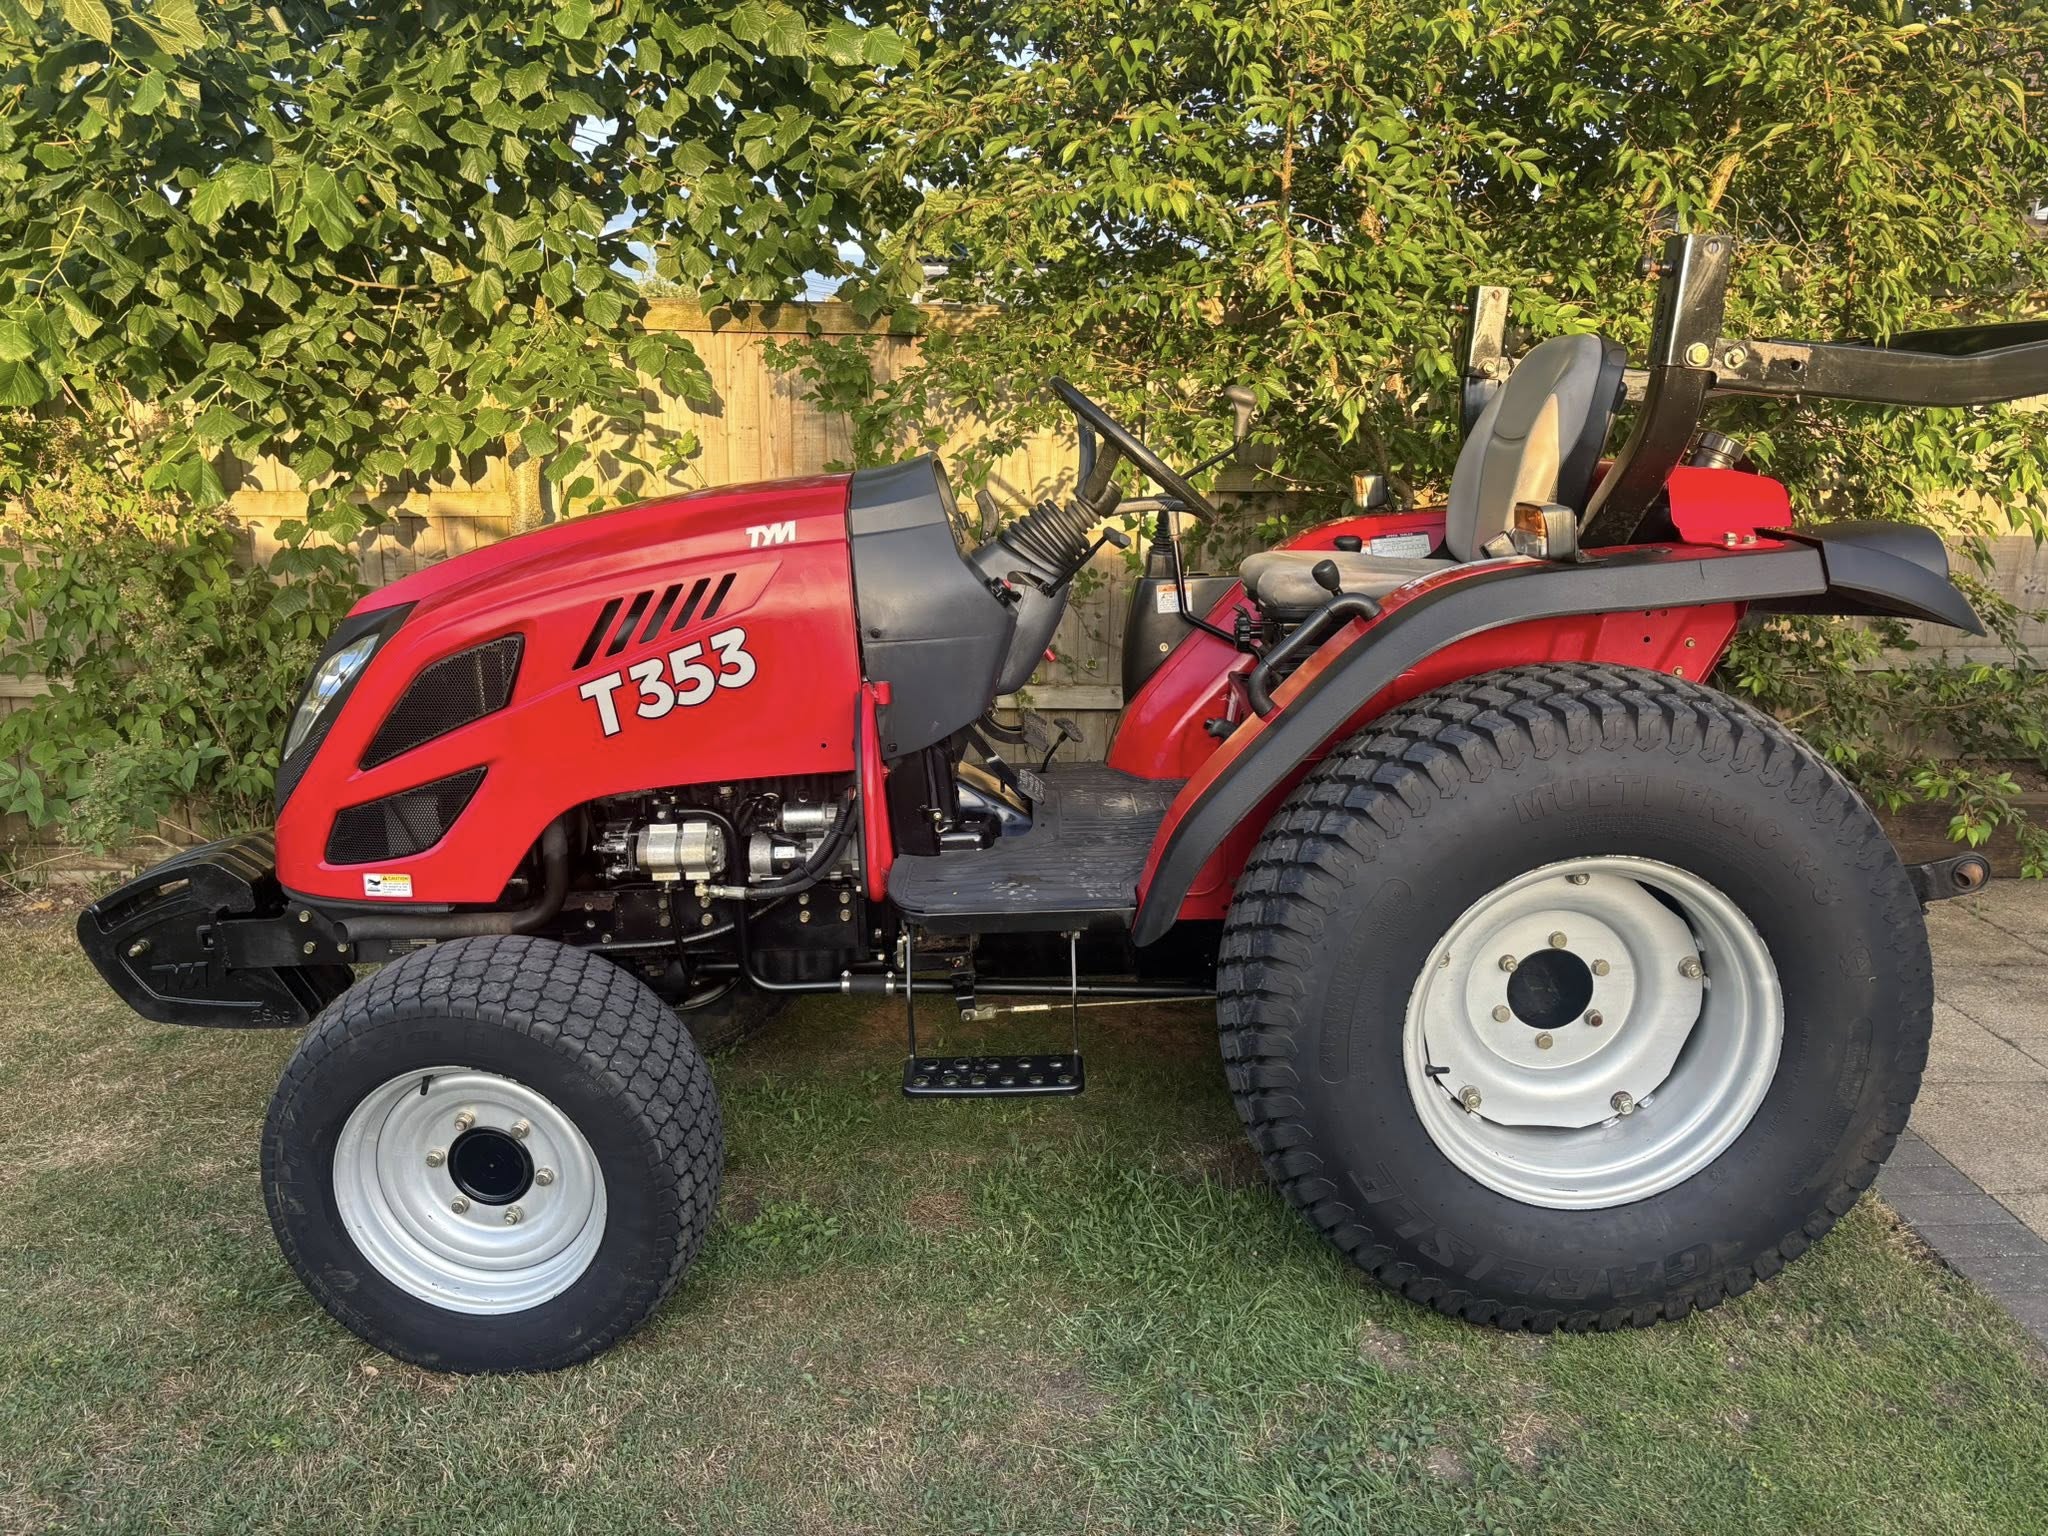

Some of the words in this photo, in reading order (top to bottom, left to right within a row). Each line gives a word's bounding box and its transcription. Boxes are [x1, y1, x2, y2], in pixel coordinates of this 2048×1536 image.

[746, 520, 796, 548] TYM
[1512, 774, 1657, 824] MULTI
[1675, 778, 1784, 850] TRAC
